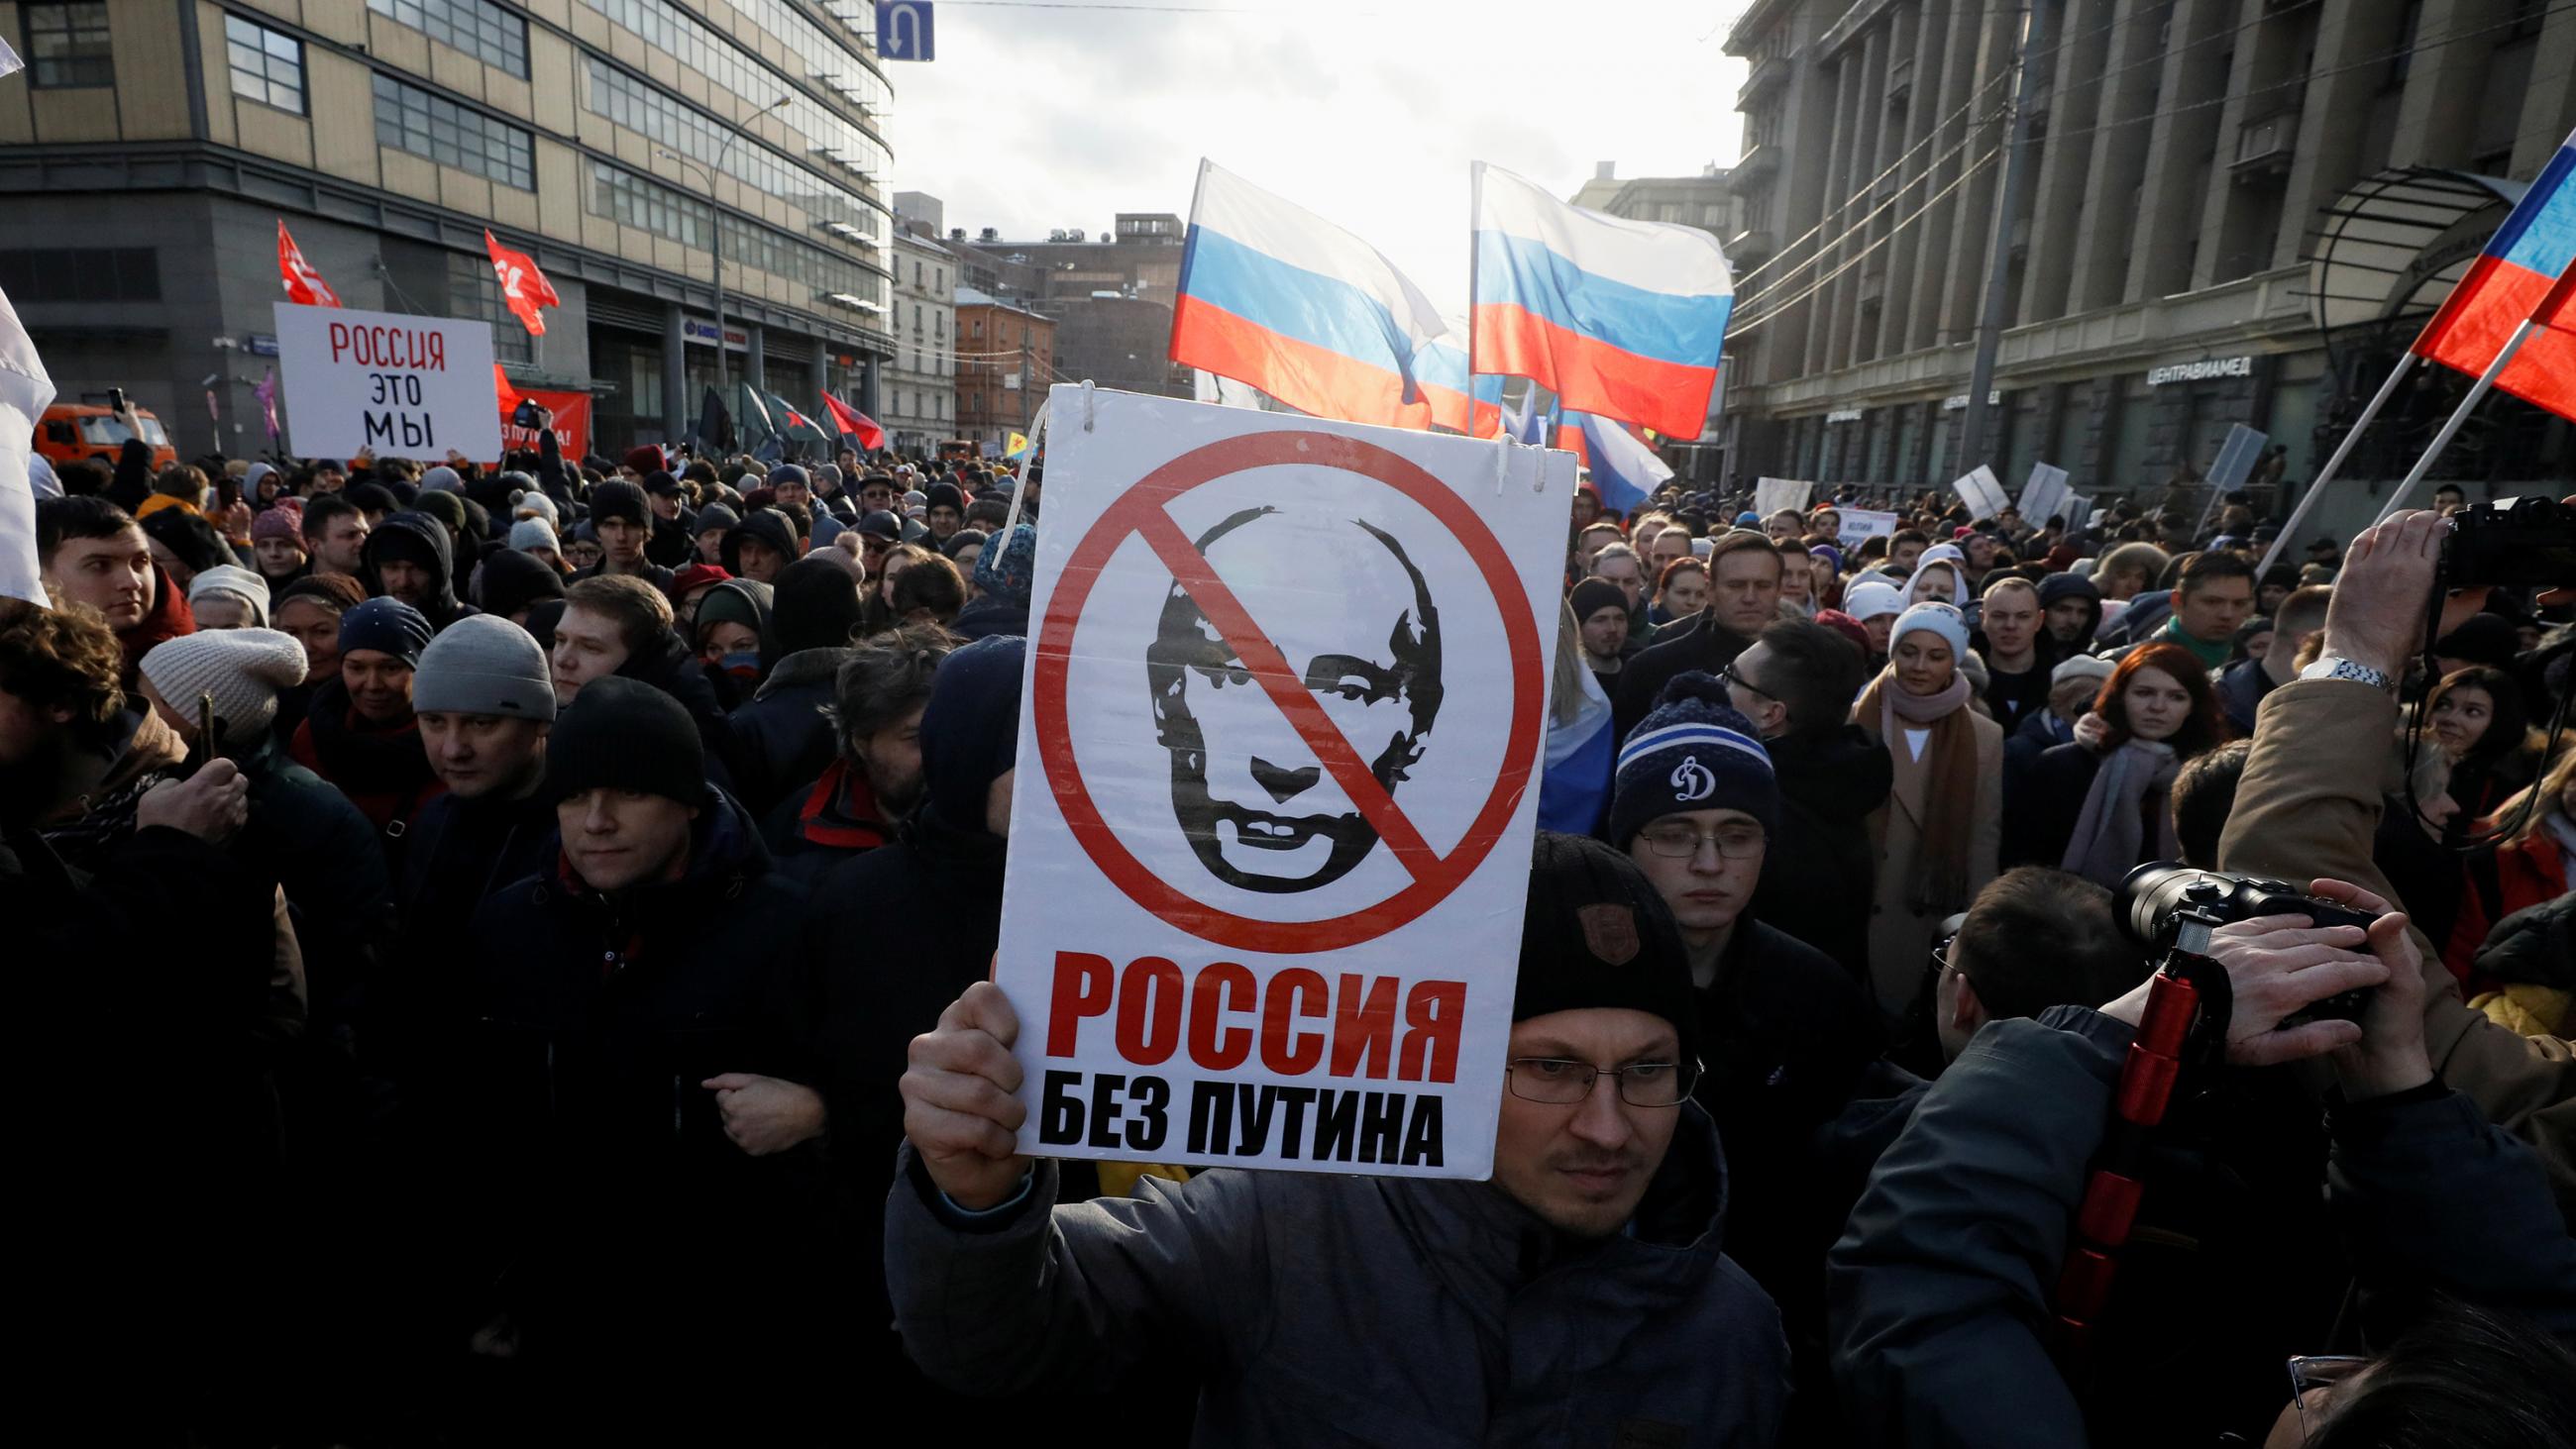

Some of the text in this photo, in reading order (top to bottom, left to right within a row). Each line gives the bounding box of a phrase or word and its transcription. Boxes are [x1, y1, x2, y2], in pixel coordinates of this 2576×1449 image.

[329, 323, 445, 371] РОССИЯ
[370, 373, 422, 406] ЭТО
[2147, 357, 2252, 385] ЦЕНТРАВИАМЕД
[363, 410, 434, 448] МЫ
[1046, 951, 1466, 1085] РОССИЯ
[1039, 1069, 1446, 1169] БЕЗ ПУТИНА
